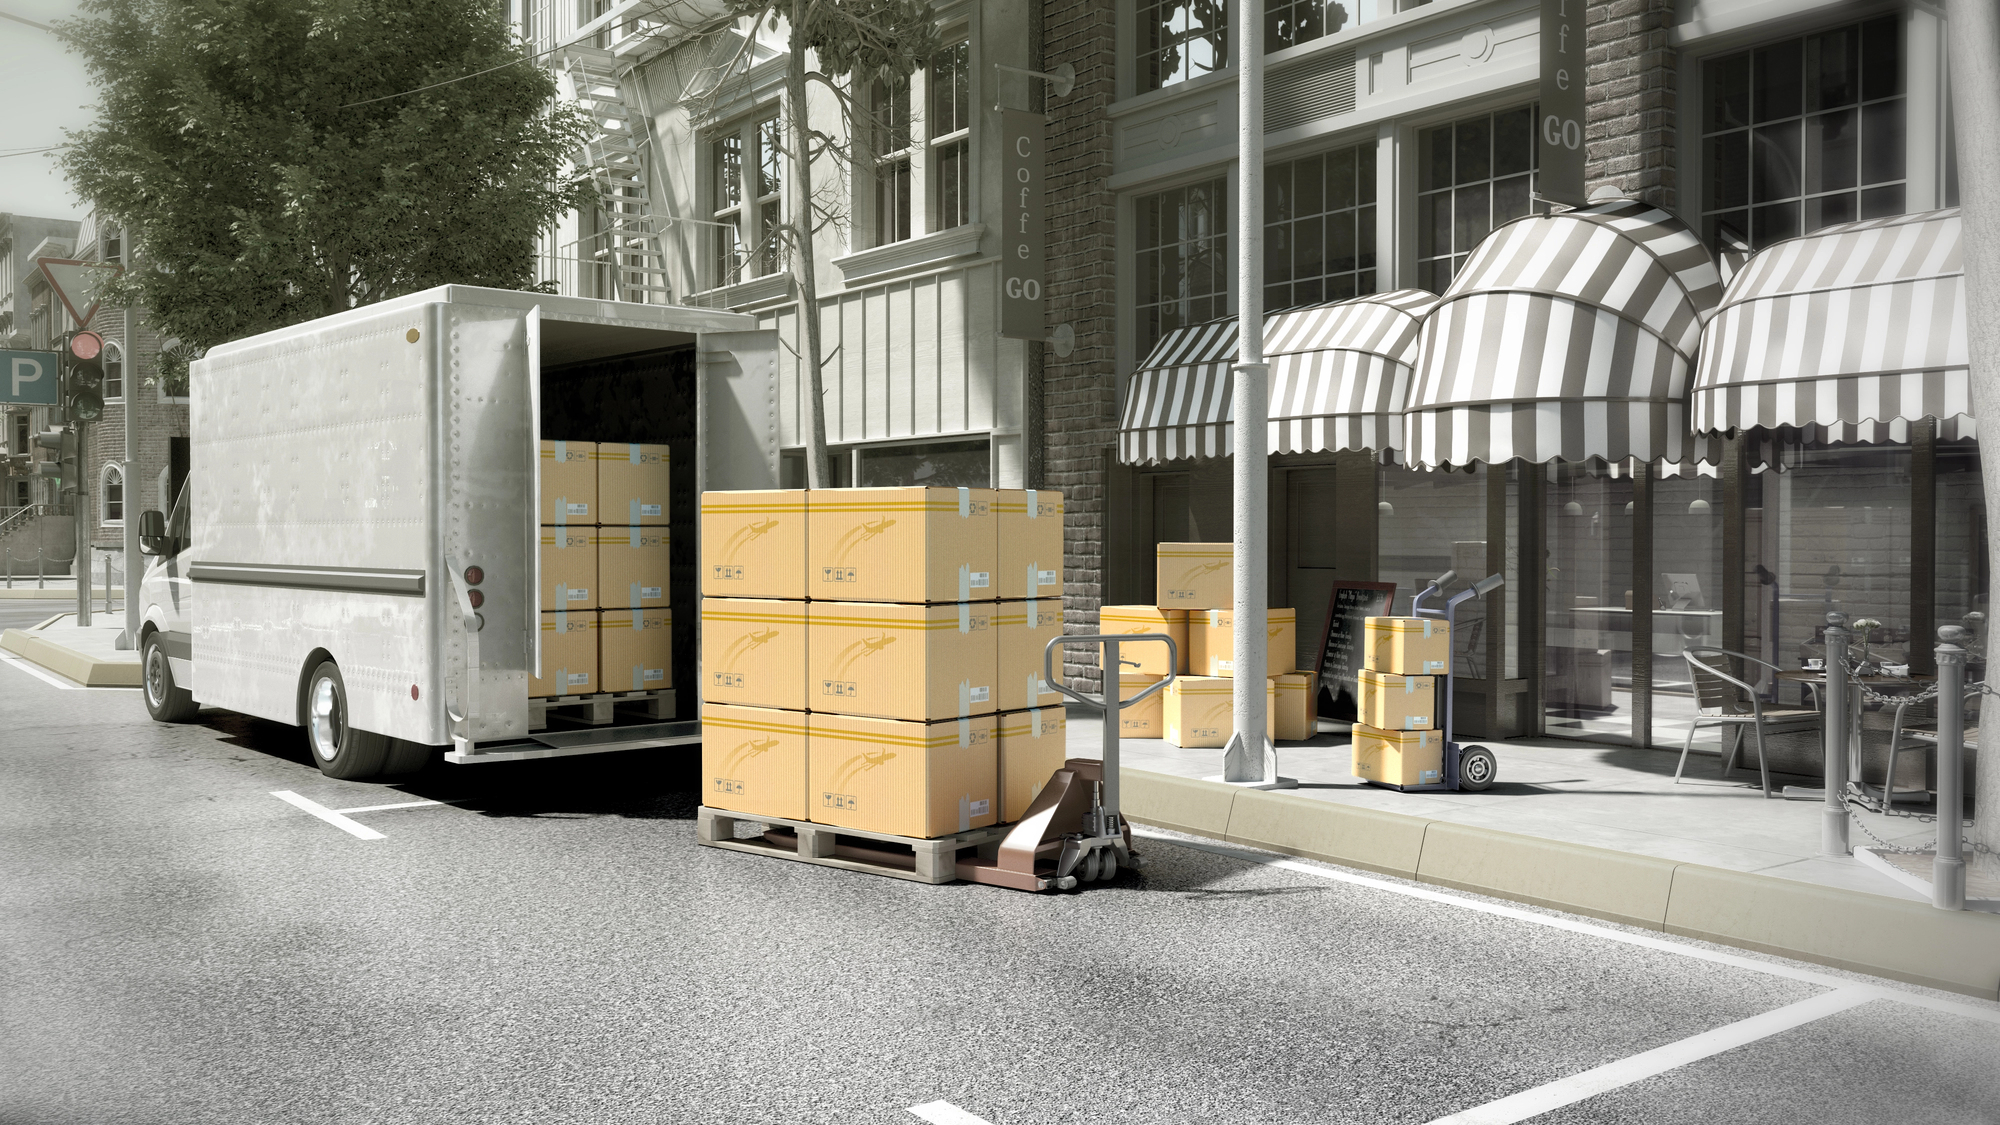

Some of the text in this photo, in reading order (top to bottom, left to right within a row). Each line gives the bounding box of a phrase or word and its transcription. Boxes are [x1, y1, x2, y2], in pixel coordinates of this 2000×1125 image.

[1543, 115, 1581, 150] GO
[1015, 136, 1031, 260] Coffe
[1006, 277, 1041, 301] GO
[11, 357, 43, 397] P
